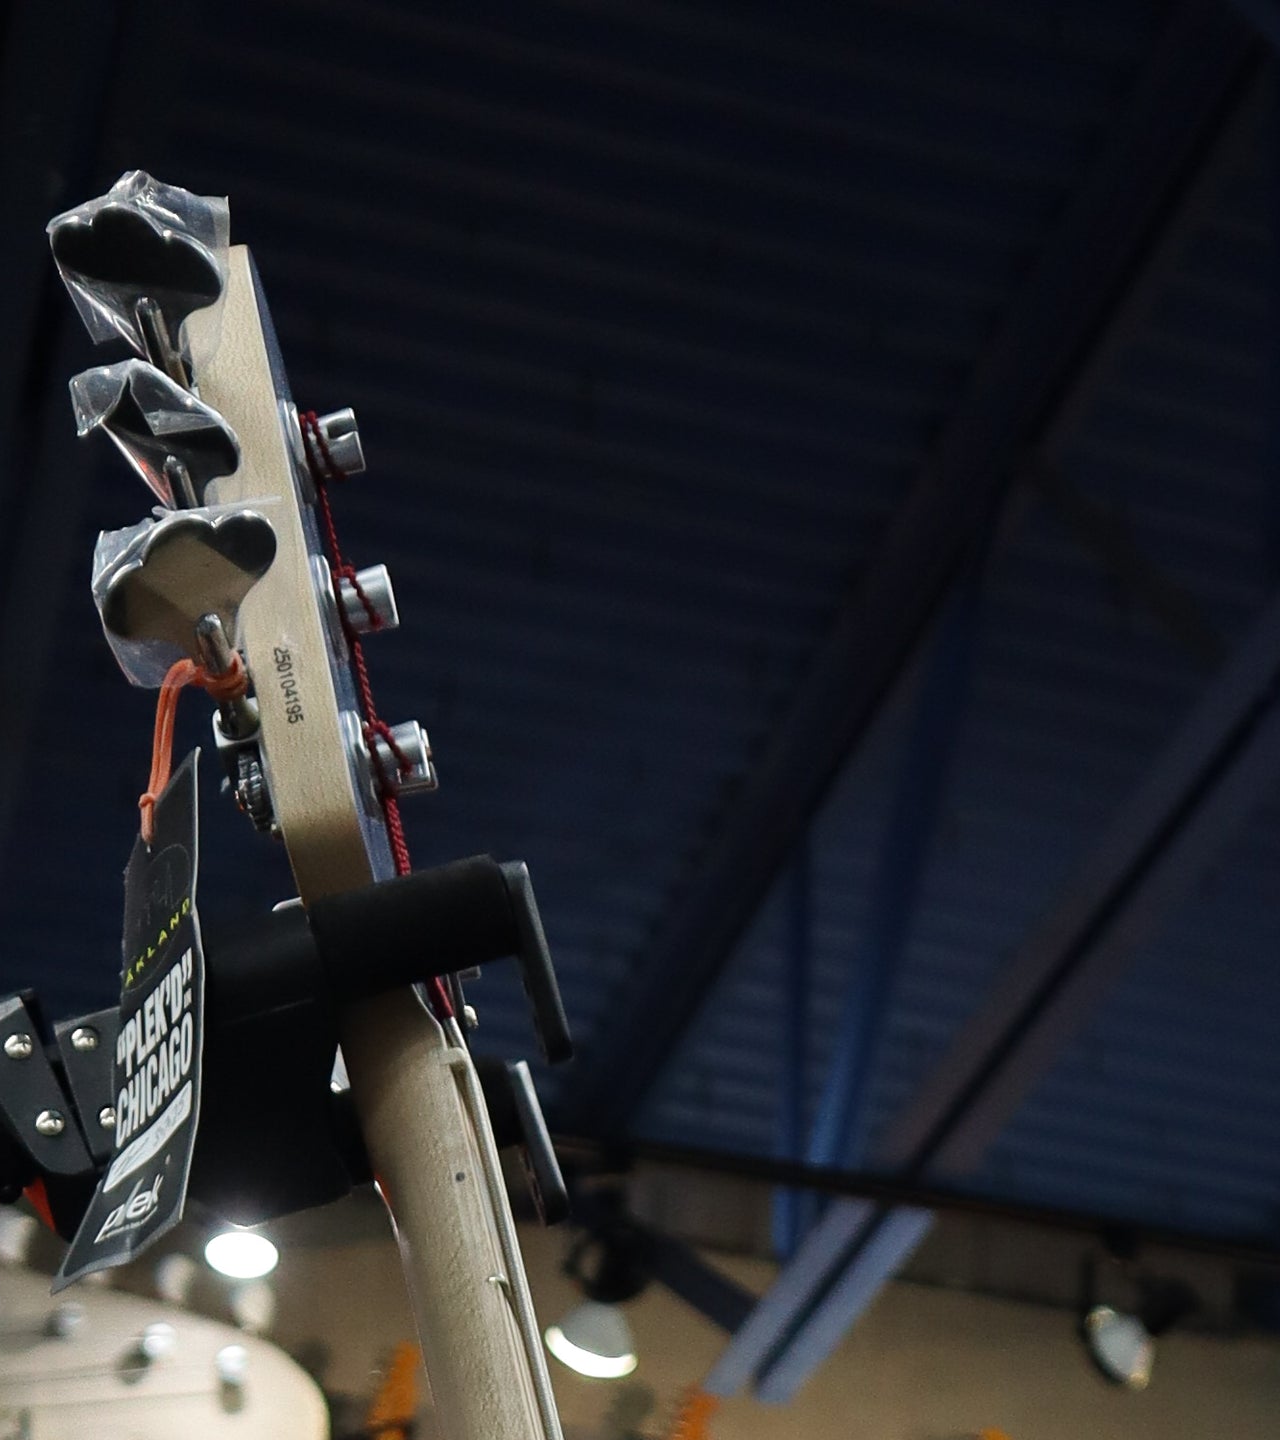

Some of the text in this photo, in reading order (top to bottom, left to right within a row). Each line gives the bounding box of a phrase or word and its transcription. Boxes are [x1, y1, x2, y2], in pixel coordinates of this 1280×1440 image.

[273, 646, 305, 724] 250104195
[125, 897, 190, 988] AKLAND
[115, 1011, 193, 1149] CHICAGO
[93, 1173, 165, 1244] plek
